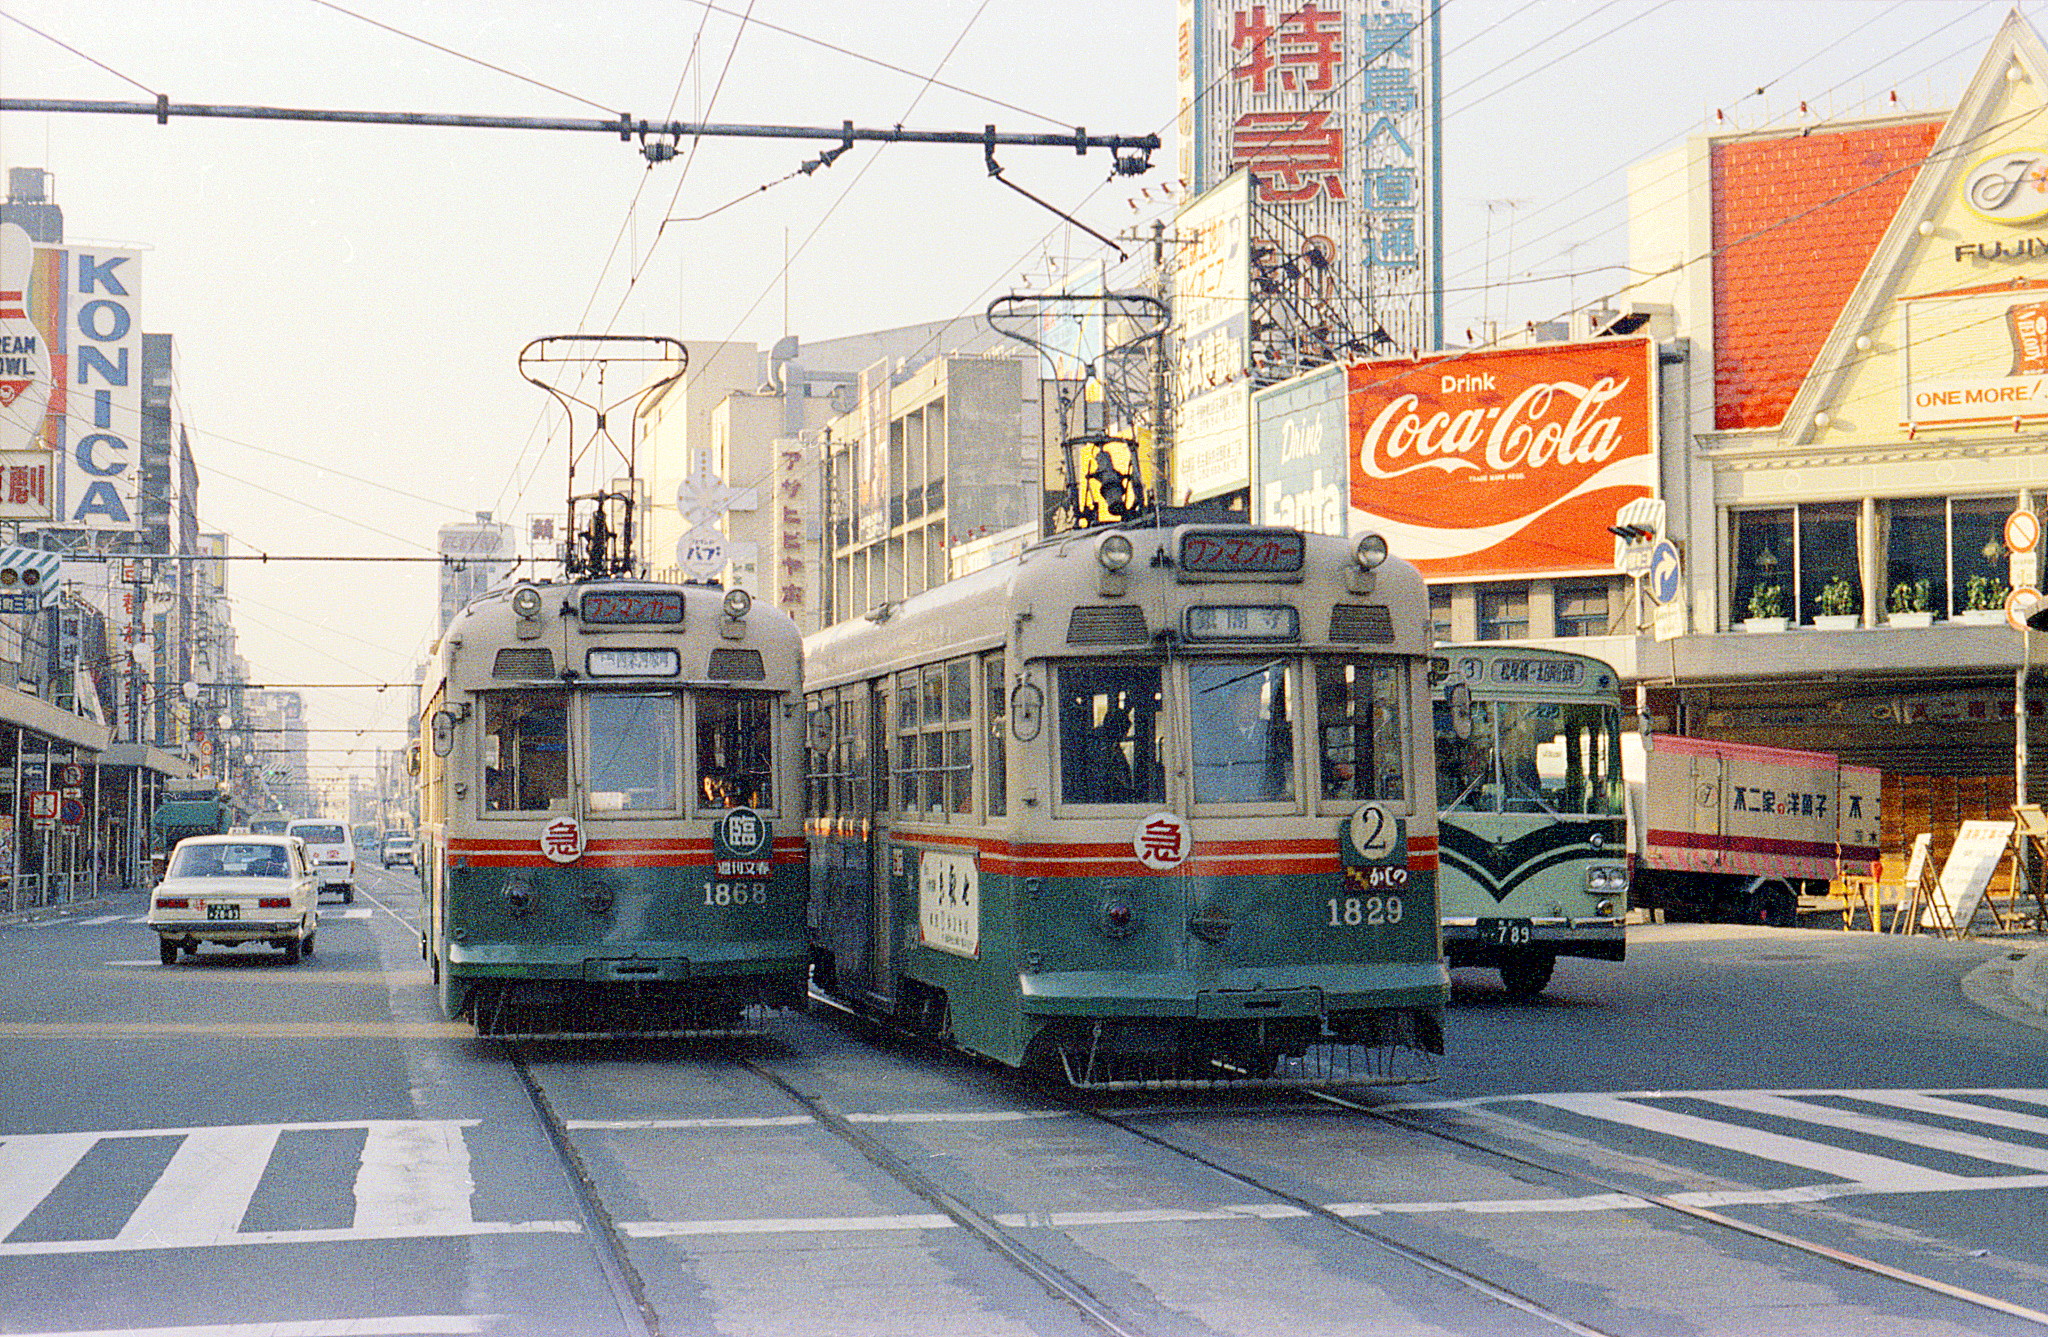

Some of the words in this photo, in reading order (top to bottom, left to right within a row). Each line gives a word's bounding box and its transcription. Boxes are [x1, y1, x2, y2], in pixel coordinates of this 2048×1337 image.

[1231, 3, 1348, 203] 特急
[0, 336, 36, 354] EAM
[74, 254, 132, 523] KONICA
[1441, 372, 1496, 394] Drink
[1916, 391, 1961, 408] ONE
[1281, 411, 1323, 465] Drink
[1360, 376, 1631, 479] Coca-Cola
[1265, 469, 1341, 537] Fanta
[1187, 537, 1297, 565] ワンマンカー
[586, 597, 679, 620] ワンマンカー
[1464, 658, 1475, 679] 3
[1734, 786, 1828, 818] 不二家の洋菓子
[545, 822, 579, 855] 急
[729, 814, 756, 847] 臨
[1140, 819, 1183, 863] 急
[1363, 806, 1387, 851] 2
[717, 861, 771, 876] 週刊文春
[703, 882, 768, 907] 1868
[1327, 896, 1404, 926] 1829
[1498, 926, 1530, 944] 789
